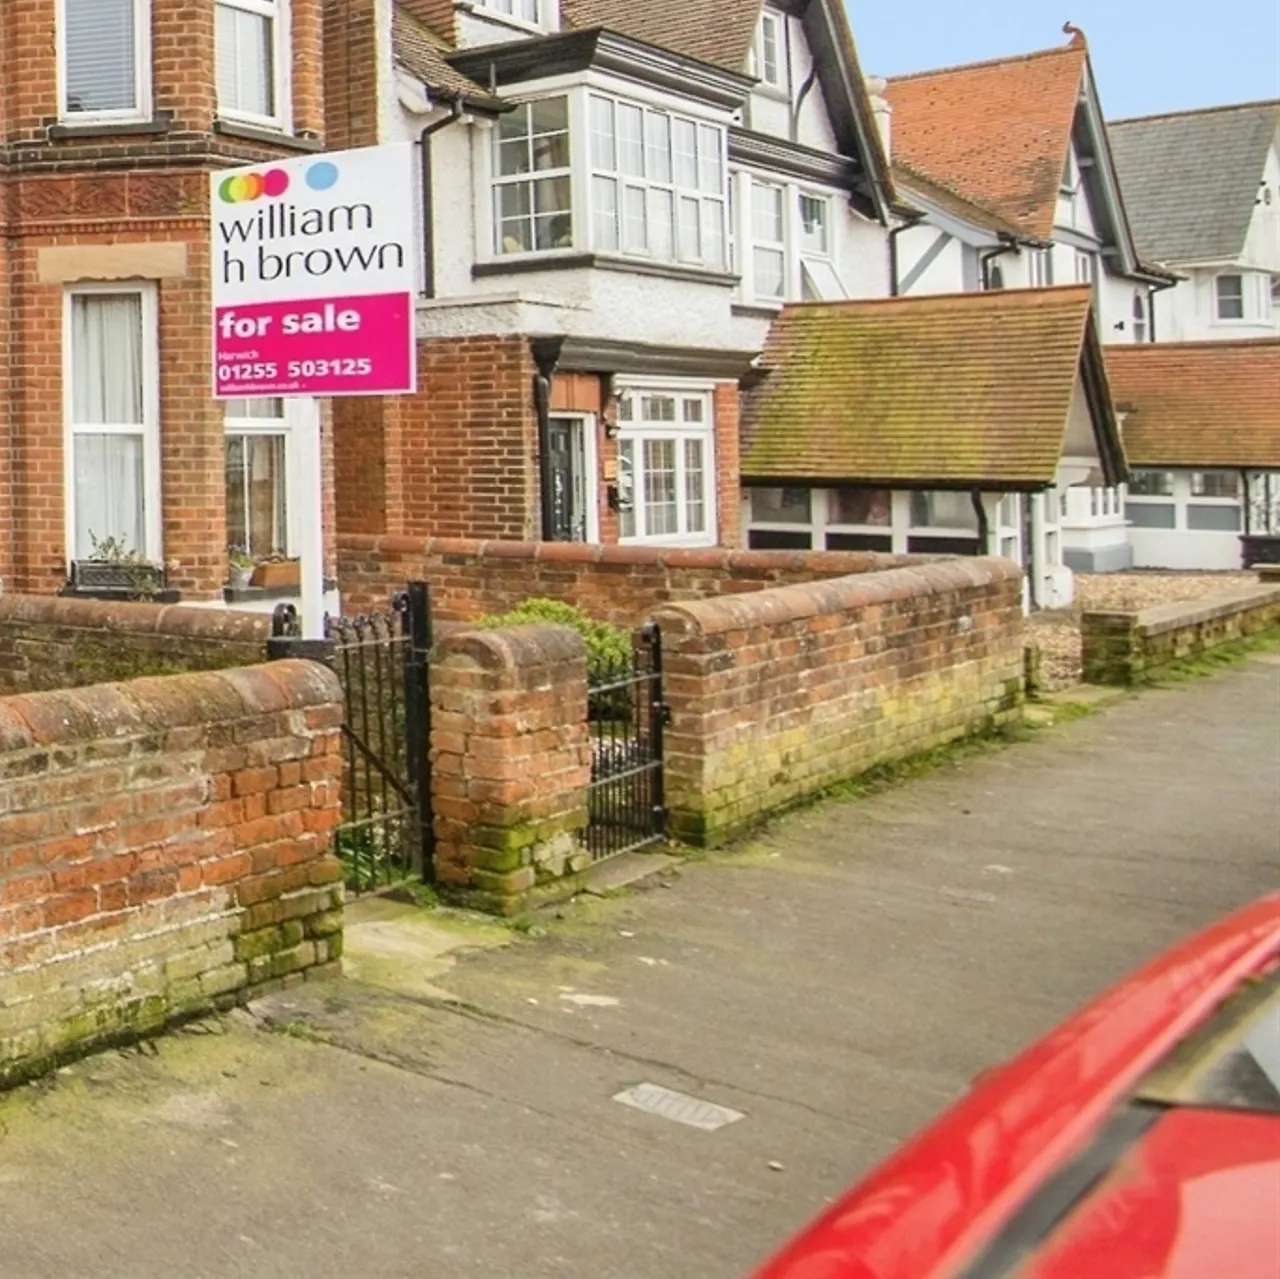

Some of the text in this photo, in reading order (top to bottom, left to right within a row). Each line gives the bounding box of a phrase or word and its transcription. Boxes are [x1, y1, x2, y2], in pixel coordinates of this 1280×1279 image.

[219, 203, 373, 244] william
[224, 242, 404, 283] h brown
[219, 303, 361, 339] for sale
[218, 358, 372, 381] 01255 503125
